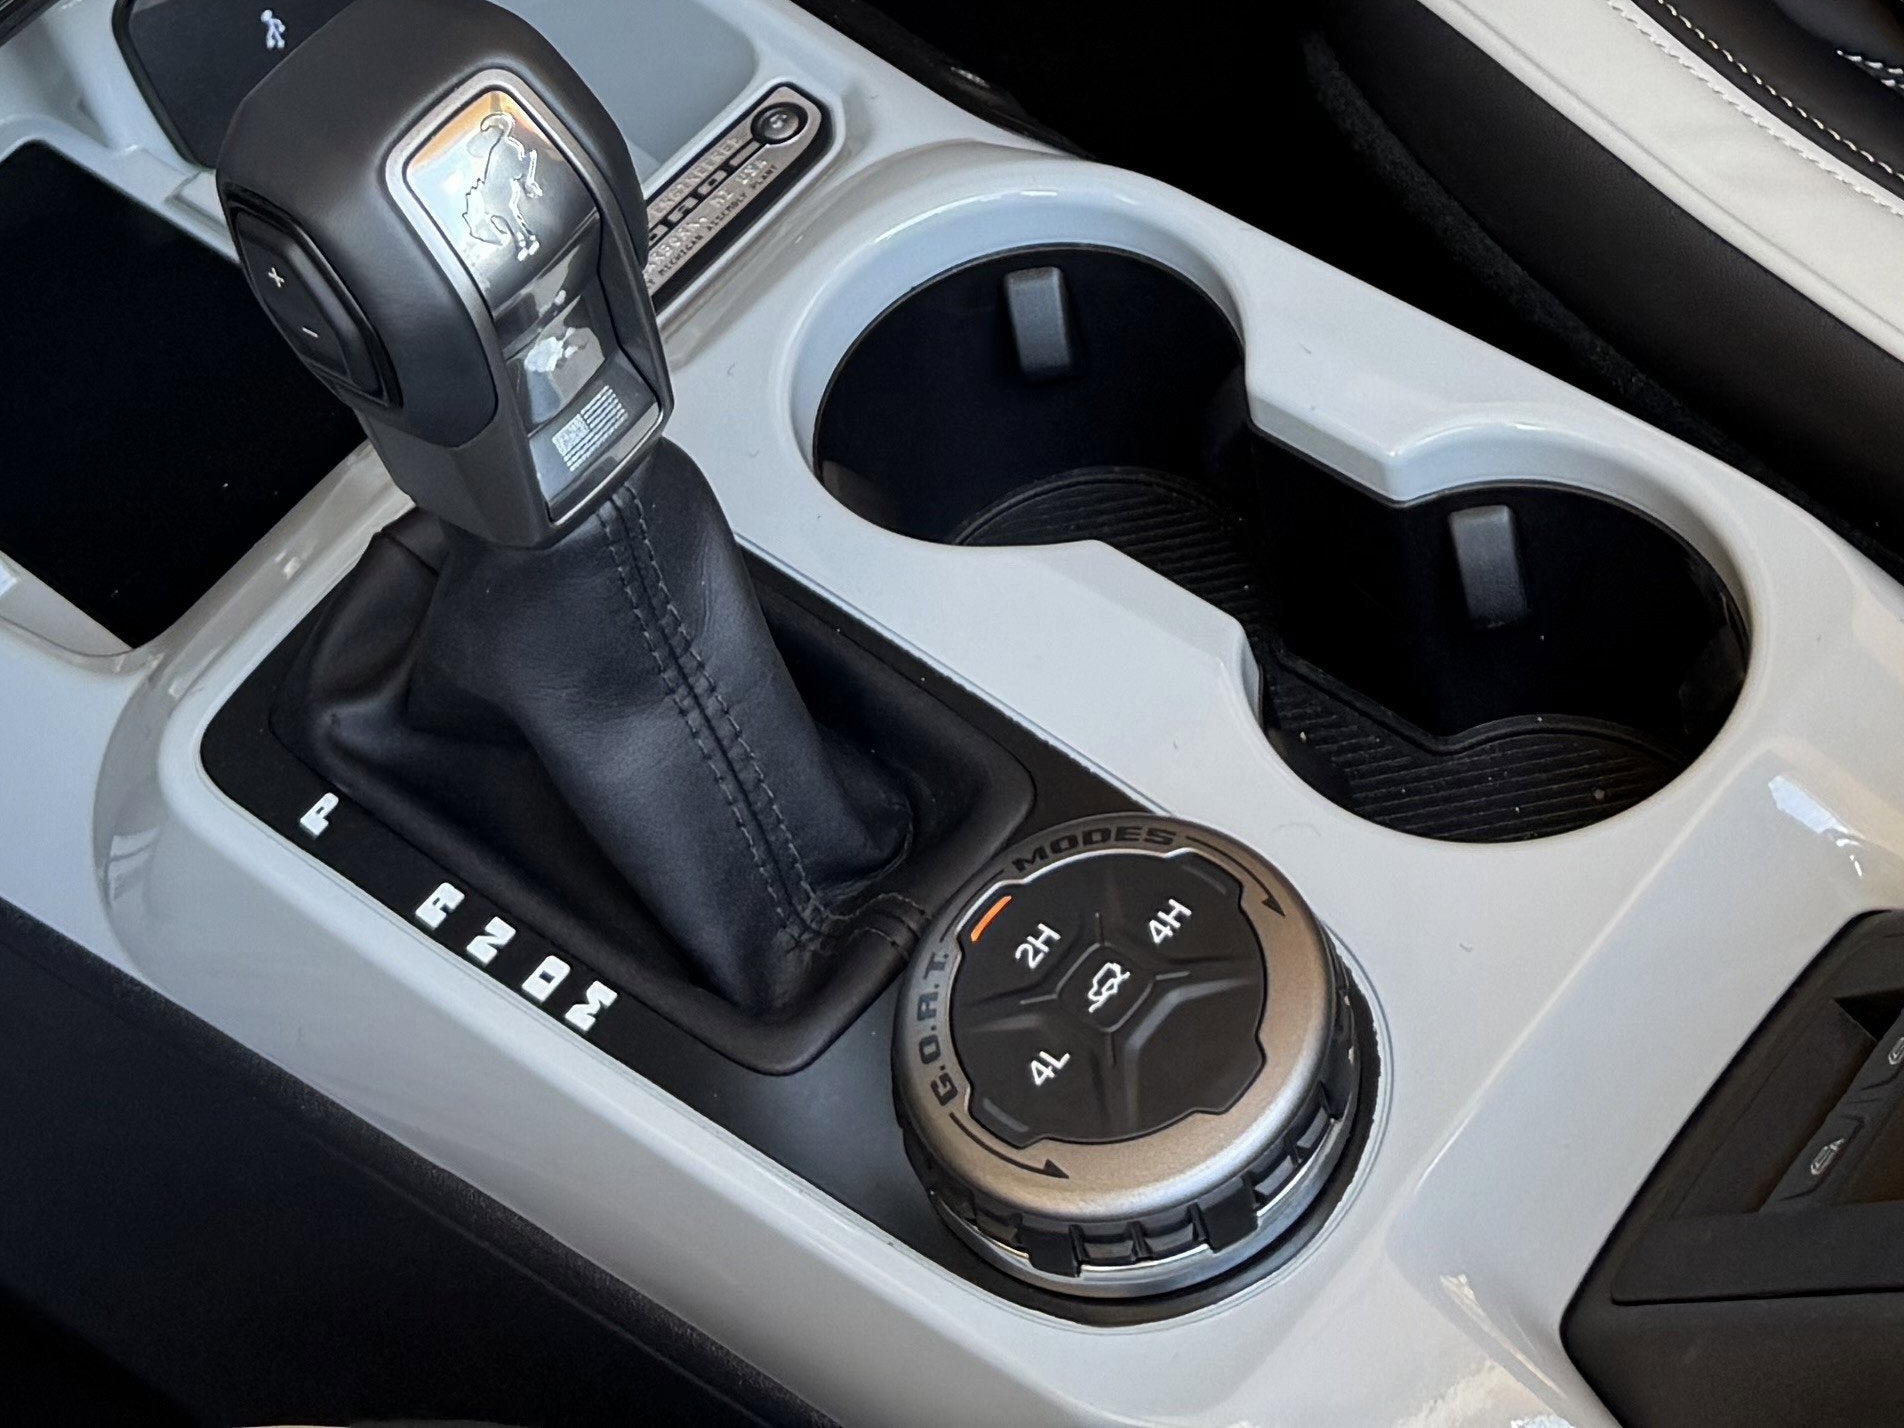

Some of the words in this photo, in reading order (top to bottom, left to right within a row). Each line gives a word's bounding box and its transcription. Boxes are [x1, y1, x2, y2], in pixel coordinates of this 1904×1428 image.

[658, 233, 703, 276] MICHIGAN
[706, 191, 747, 232] ASSEMBLY
[1012, 825, 1178, 873] MODES
[299, 792, 340, 839] P
[415, 882, 465, 929] R
[466, 916, 517, 966] N
[521, 955, 571, 1004] D
[565, 981, 618, 1034] M
[1147, 898, 1193, 948] 4H
[1014, 923, 1062, 971] 2H
[1026, 1047, 1073, 1088] 4L
